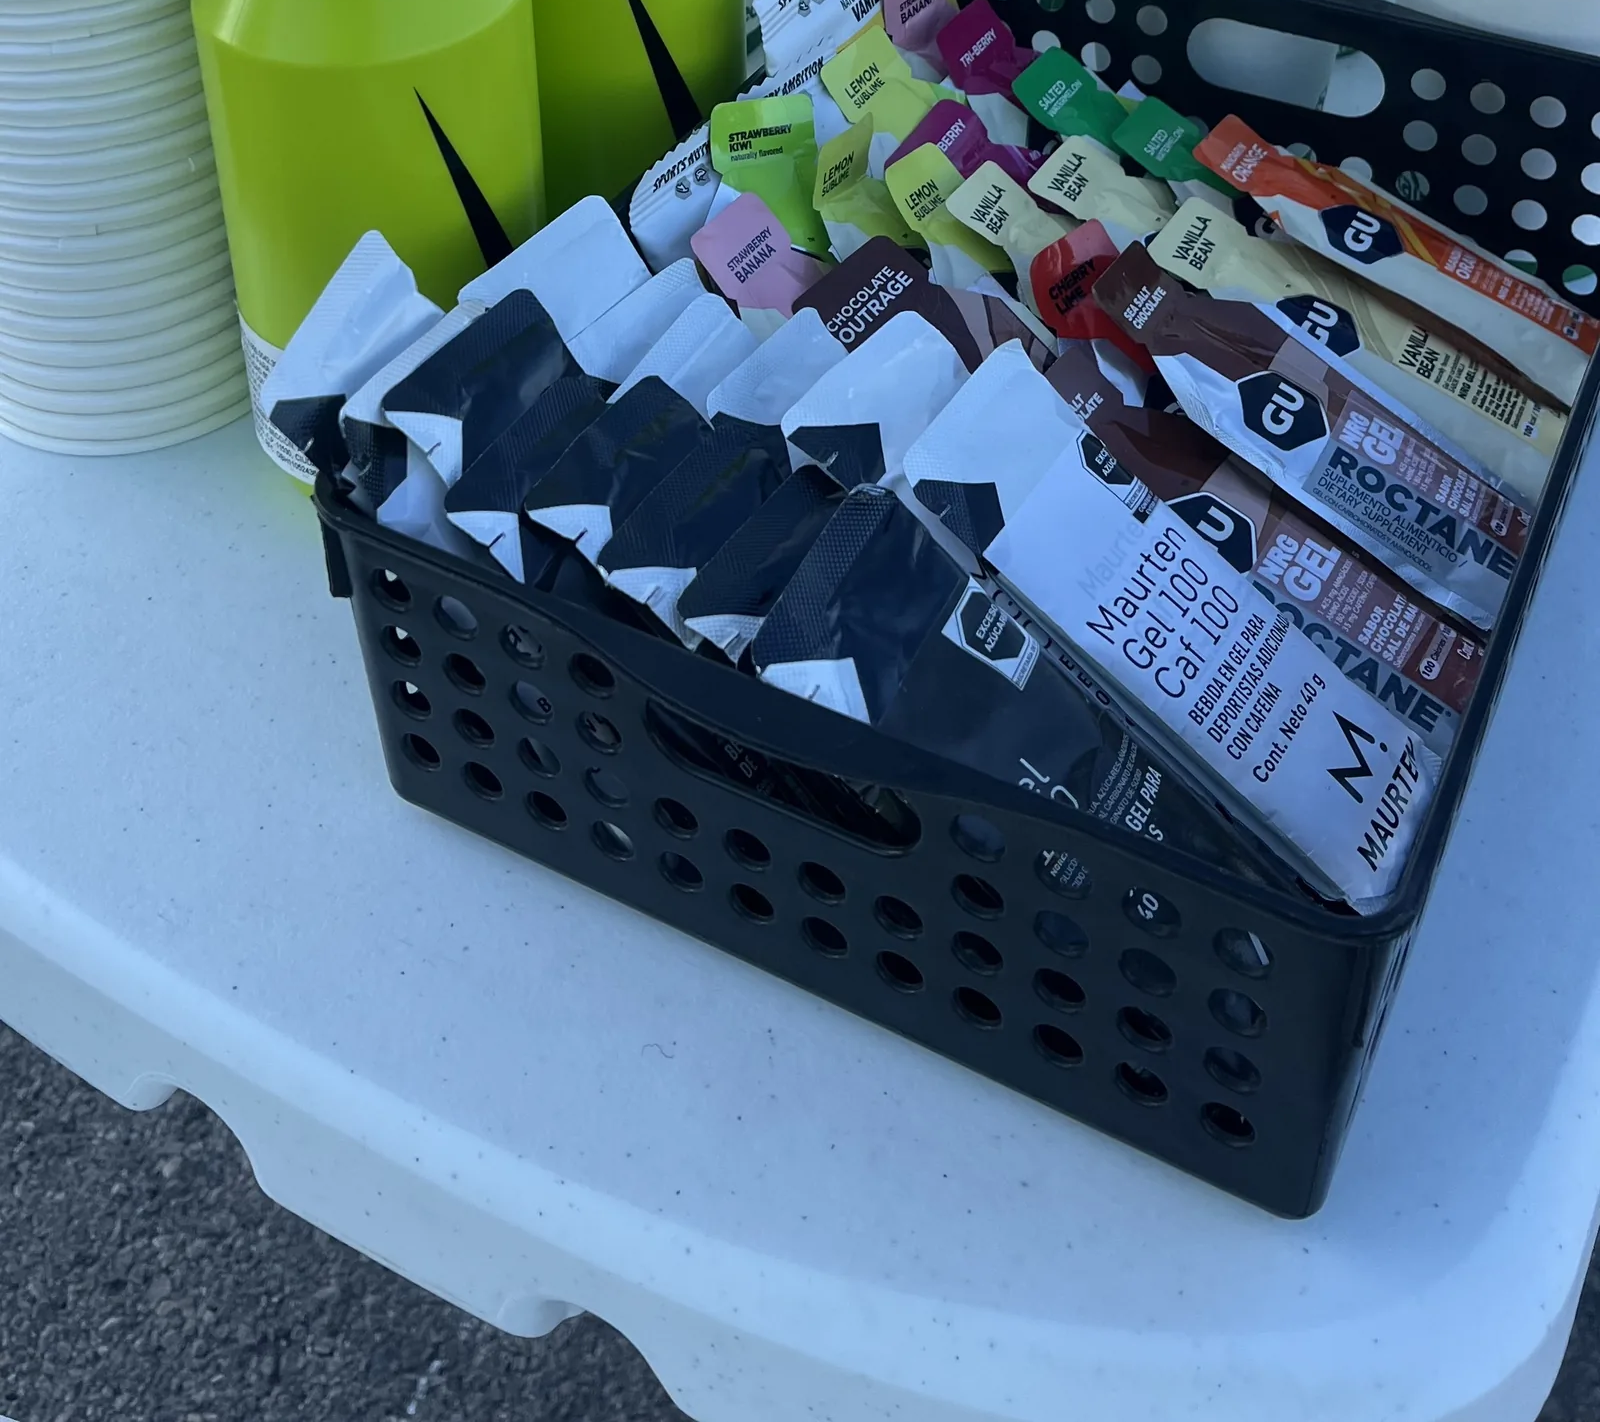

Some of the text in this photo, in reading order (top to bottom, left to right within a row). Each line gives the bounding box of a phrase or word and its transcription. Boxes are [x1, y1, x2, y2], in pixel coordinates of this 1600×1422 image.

[960, 28, 997, 68] TRI-BERRY
[781, 55, 825, 97] AMBITION
[844, 62, 880, 100] LEMON
[853, 76, 886, 109] SUBLIME
[1038, 80, 1067, 111] SALTED
[1047, 79, 1083, 118] WATERMELON
[728, 123, 793, 143] STRAWBERRY
[729, 140, 753, 153] KIWI
[1144, 129, 1168, 158] SALTED
[1155, 125, 1185, 163] WATERMELON
[730, 145, 784, 162] naturally flavored
[822, 151, 856, 184] LEMON
[1047, 152, 1087, 193] VANILLA
[1232, 143, 1268, 183] ORANGE
[652, 156, 689, 193] SPORTS
[820, 168, 851, 198] SUBLIME
[904, 178, 940, 211] LEMON
[1063, 174, 1090, 203] BEAN
[913, 194, 946, 222] SUBLIME
[970, 184, 1007, 224] VANILLA
[985, 206, 1010, 236] BEAN
[727, 226, 773, 273] STRAWBERRY
[1172, 214, 1213, 262] VANILLA
[1343, 210, 1381, 253] GU
[733, 243, 777, 285] BANANA
[1188, 237, 1216, 271] BEAN
[827, 265, 895, 333] CHOCOLATE
[1048, 258, 1098, 301] CHERRY
[838, 270, 914, 345] OUTRAGE
[1055, 285, 1087, 316] LIME
[1123, 285, 1151, 322] SEA SALT
[1132, 285, 1167, 330] CHOCOLATE
[1300, 300, 1339, 347] GU
[1399, 324, 1429, 368] VANILL
[1416, 346, 1441, 379] BEAN
[1457, 382, 1471, 401] NRG
[1464, 363, 1477, 384] GEL
[1261, 383, 1305, 438] GU
[1338, 410, 1371, 450] NRG
[1361, 414, 1406, 465] GEL
[1523, 424, 1534, 438] 100
[1312, 486, 1325, 499] GEL
[1323, 494, 1339, 510] CON
[1434, 472, 1454, 504] SABOR
[1458, 488, 1475, 518] SAL DE
[1317, 476, 1430, 557] DIETARY SUPPLEMENT
[1322, 466, 1392, 517] SUPLEMENTO
[1393, 514, 1458, 563] ALIMENTICIO
[1328, 446, 1518, 581] ROCTANE
[1256, 532, 1300, 585] NRG
[1282, 537, 1343, 603] GEL
[1085, 526, 1187, 645] Maurten
[1328, 586, 1338, 599] mg
[975, 603, 999, 640] EXCESO
[1122, 557, 1209, 670] Gel 100
[1325, 601, 1342, 622] AMINO
[1335, 611, 1346, 627] 180
[1342, 601, 1352, 615] mg
[1344, 621, 1352, 633] 35
[1348, 611, 1358, 625] mg
[1356, 605, 1386, 646] SABOR
[1154, 585, 1240, 699] Caf 100
[1382, 619, 1410, 662] SAL DE
[1188, 612, 1267, 727] BEBIDA EN GEL PARA
[1420, 659, 1437, 679] 100
[1206, 665, 1264, 744] DEPORTISTAS
[1226, 681, 1283, 762] CON CAFEÍNA
[1252, 672, 1327, 784] Cont. Neto 40 g
[1097, 763, 1122, 800] AZÚCARES
[1104, 769, 1131, 812] CARBONATO
[1125, 800, 1152, 832] GEL
[1139, 765, 1163, 806] PARA
[1126, 787, 1137, 801] DE
